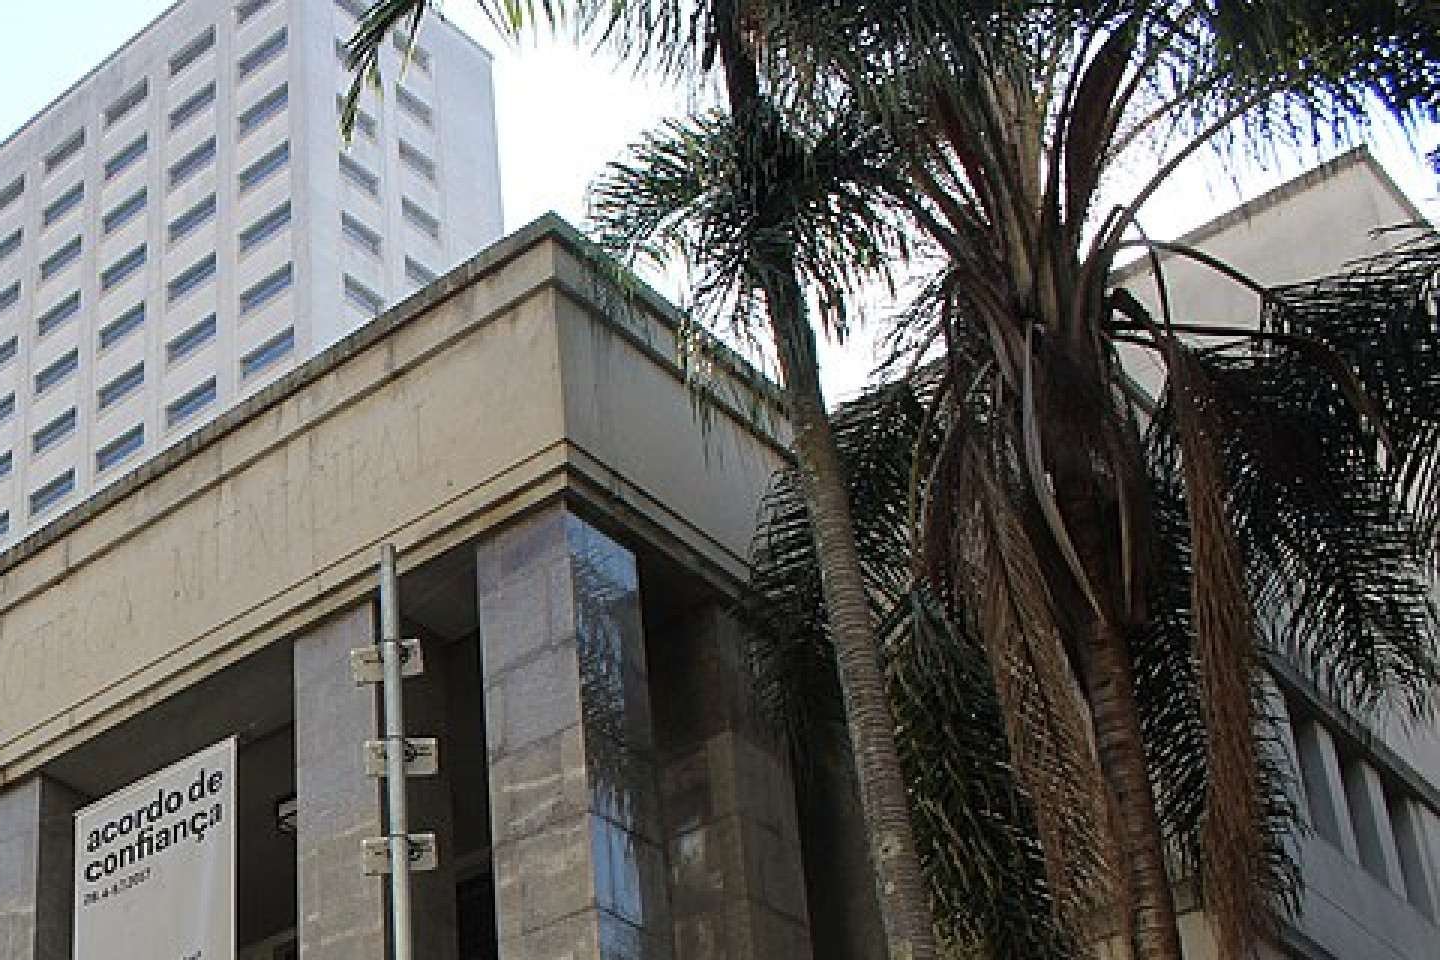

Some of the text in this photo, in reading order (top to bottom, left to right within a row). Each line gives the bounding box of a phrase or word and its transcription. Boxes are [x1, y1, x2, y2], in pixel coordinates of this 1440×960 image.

[84, 803, 223, 882] confiança
[86, 768, 223, 852] acordo de
